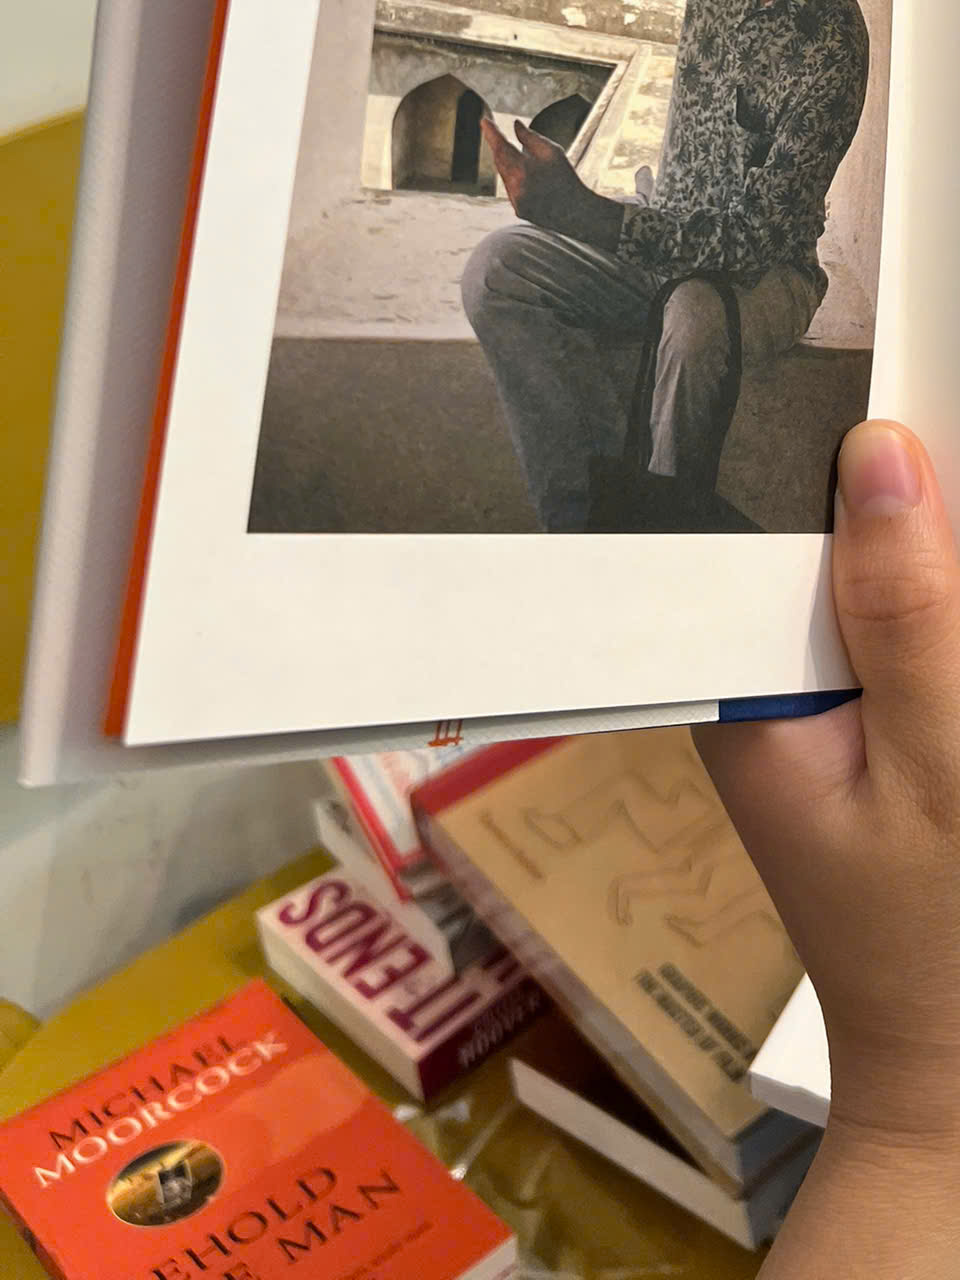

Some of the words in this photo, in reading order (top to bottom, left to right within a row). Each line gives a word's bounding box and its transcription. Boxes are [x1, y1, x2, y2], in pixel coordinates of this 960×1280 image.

[278, 880, 435, 1000] ENDS
[386, 980, 481, 1042] IT
[33, 1031, 289, 1188] MOORCOCK
[48, 1035, 240, 1150] MICHAEL
[277, 1169, 401, 1266] MAN
